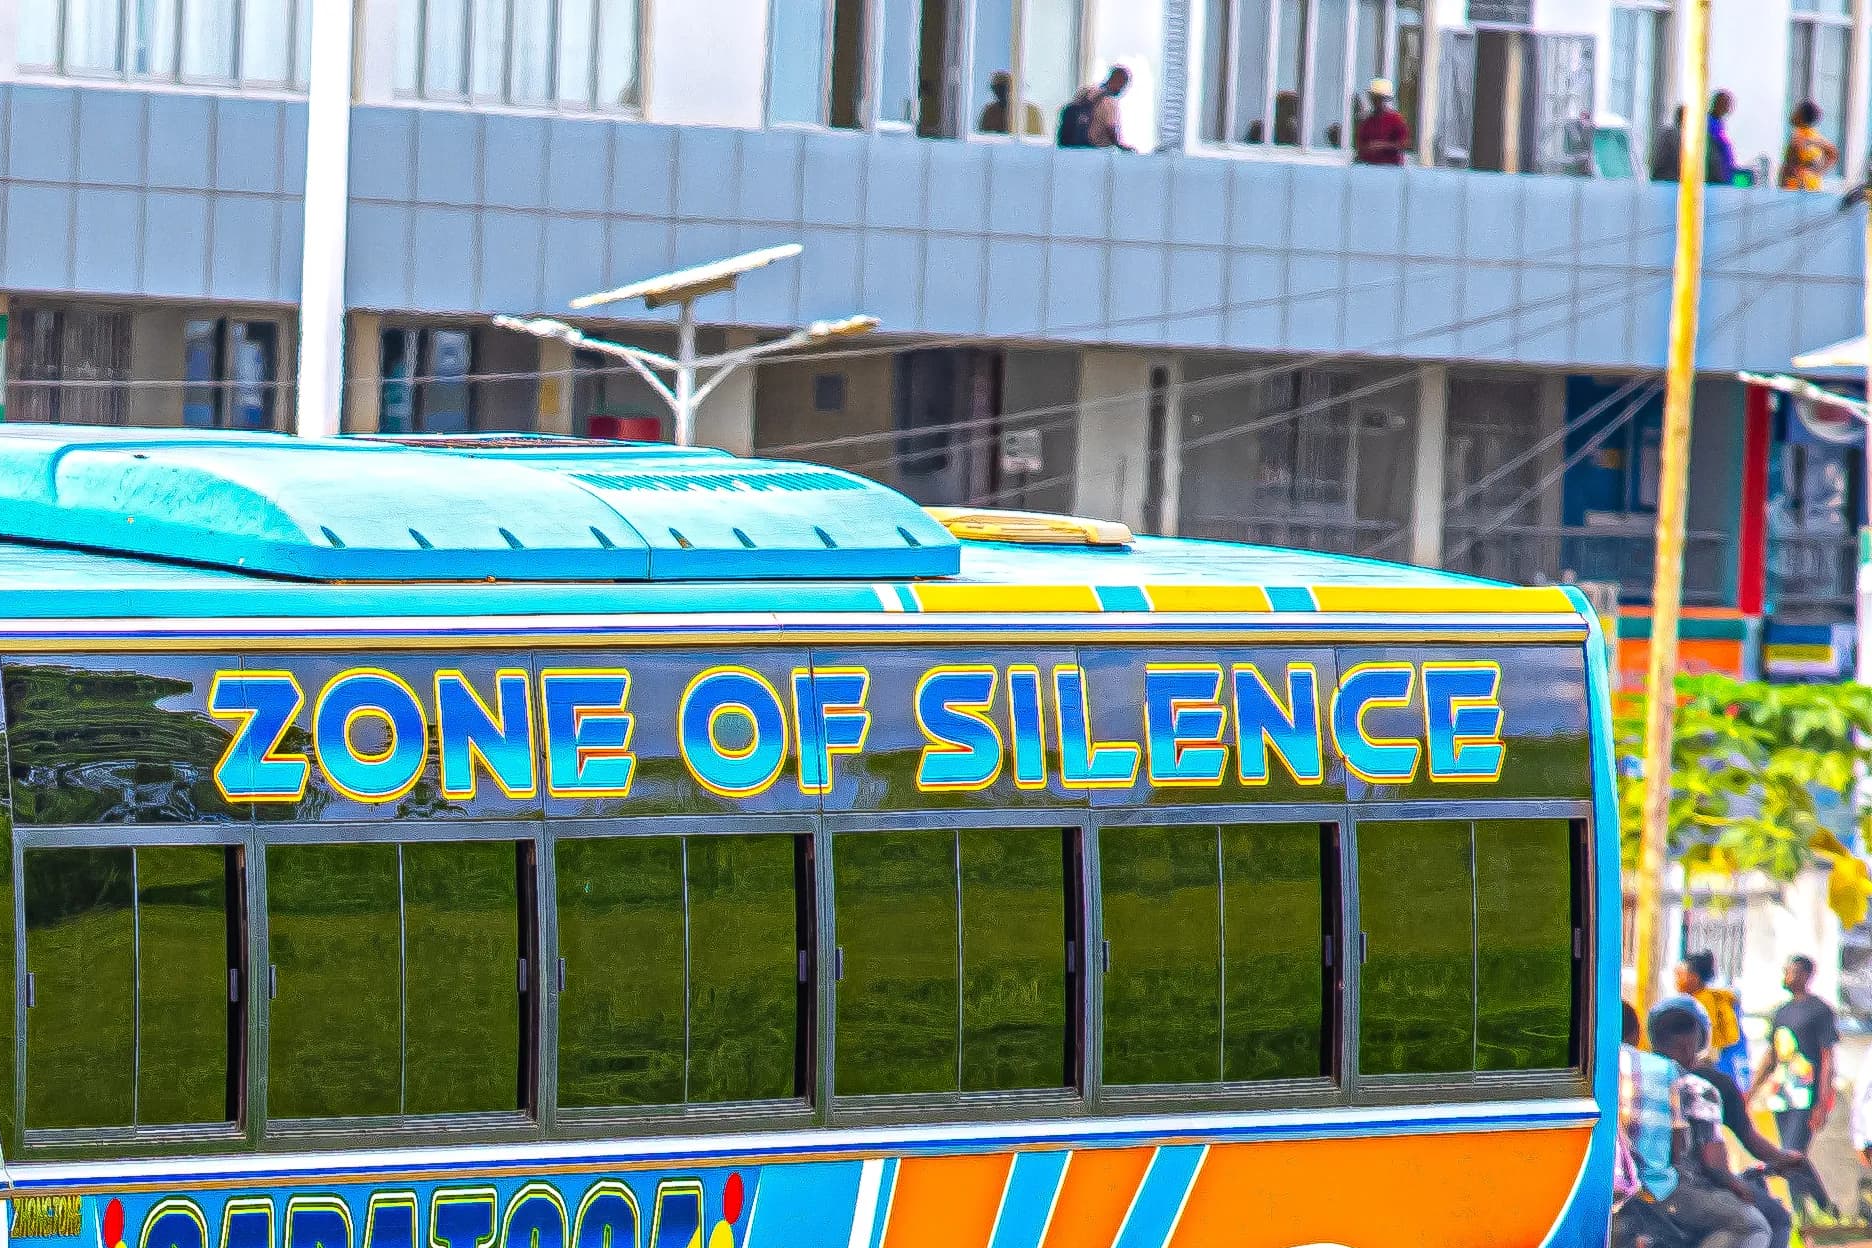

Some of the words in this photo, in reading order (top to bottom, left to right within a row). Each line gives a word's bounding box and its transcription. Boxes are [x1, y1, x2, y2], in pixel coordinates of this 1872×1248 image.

[208, 667, 637, 803] ZONE
[678, 664, 871, 798] OF
[914, 660, 1507, 792] SILENCE
